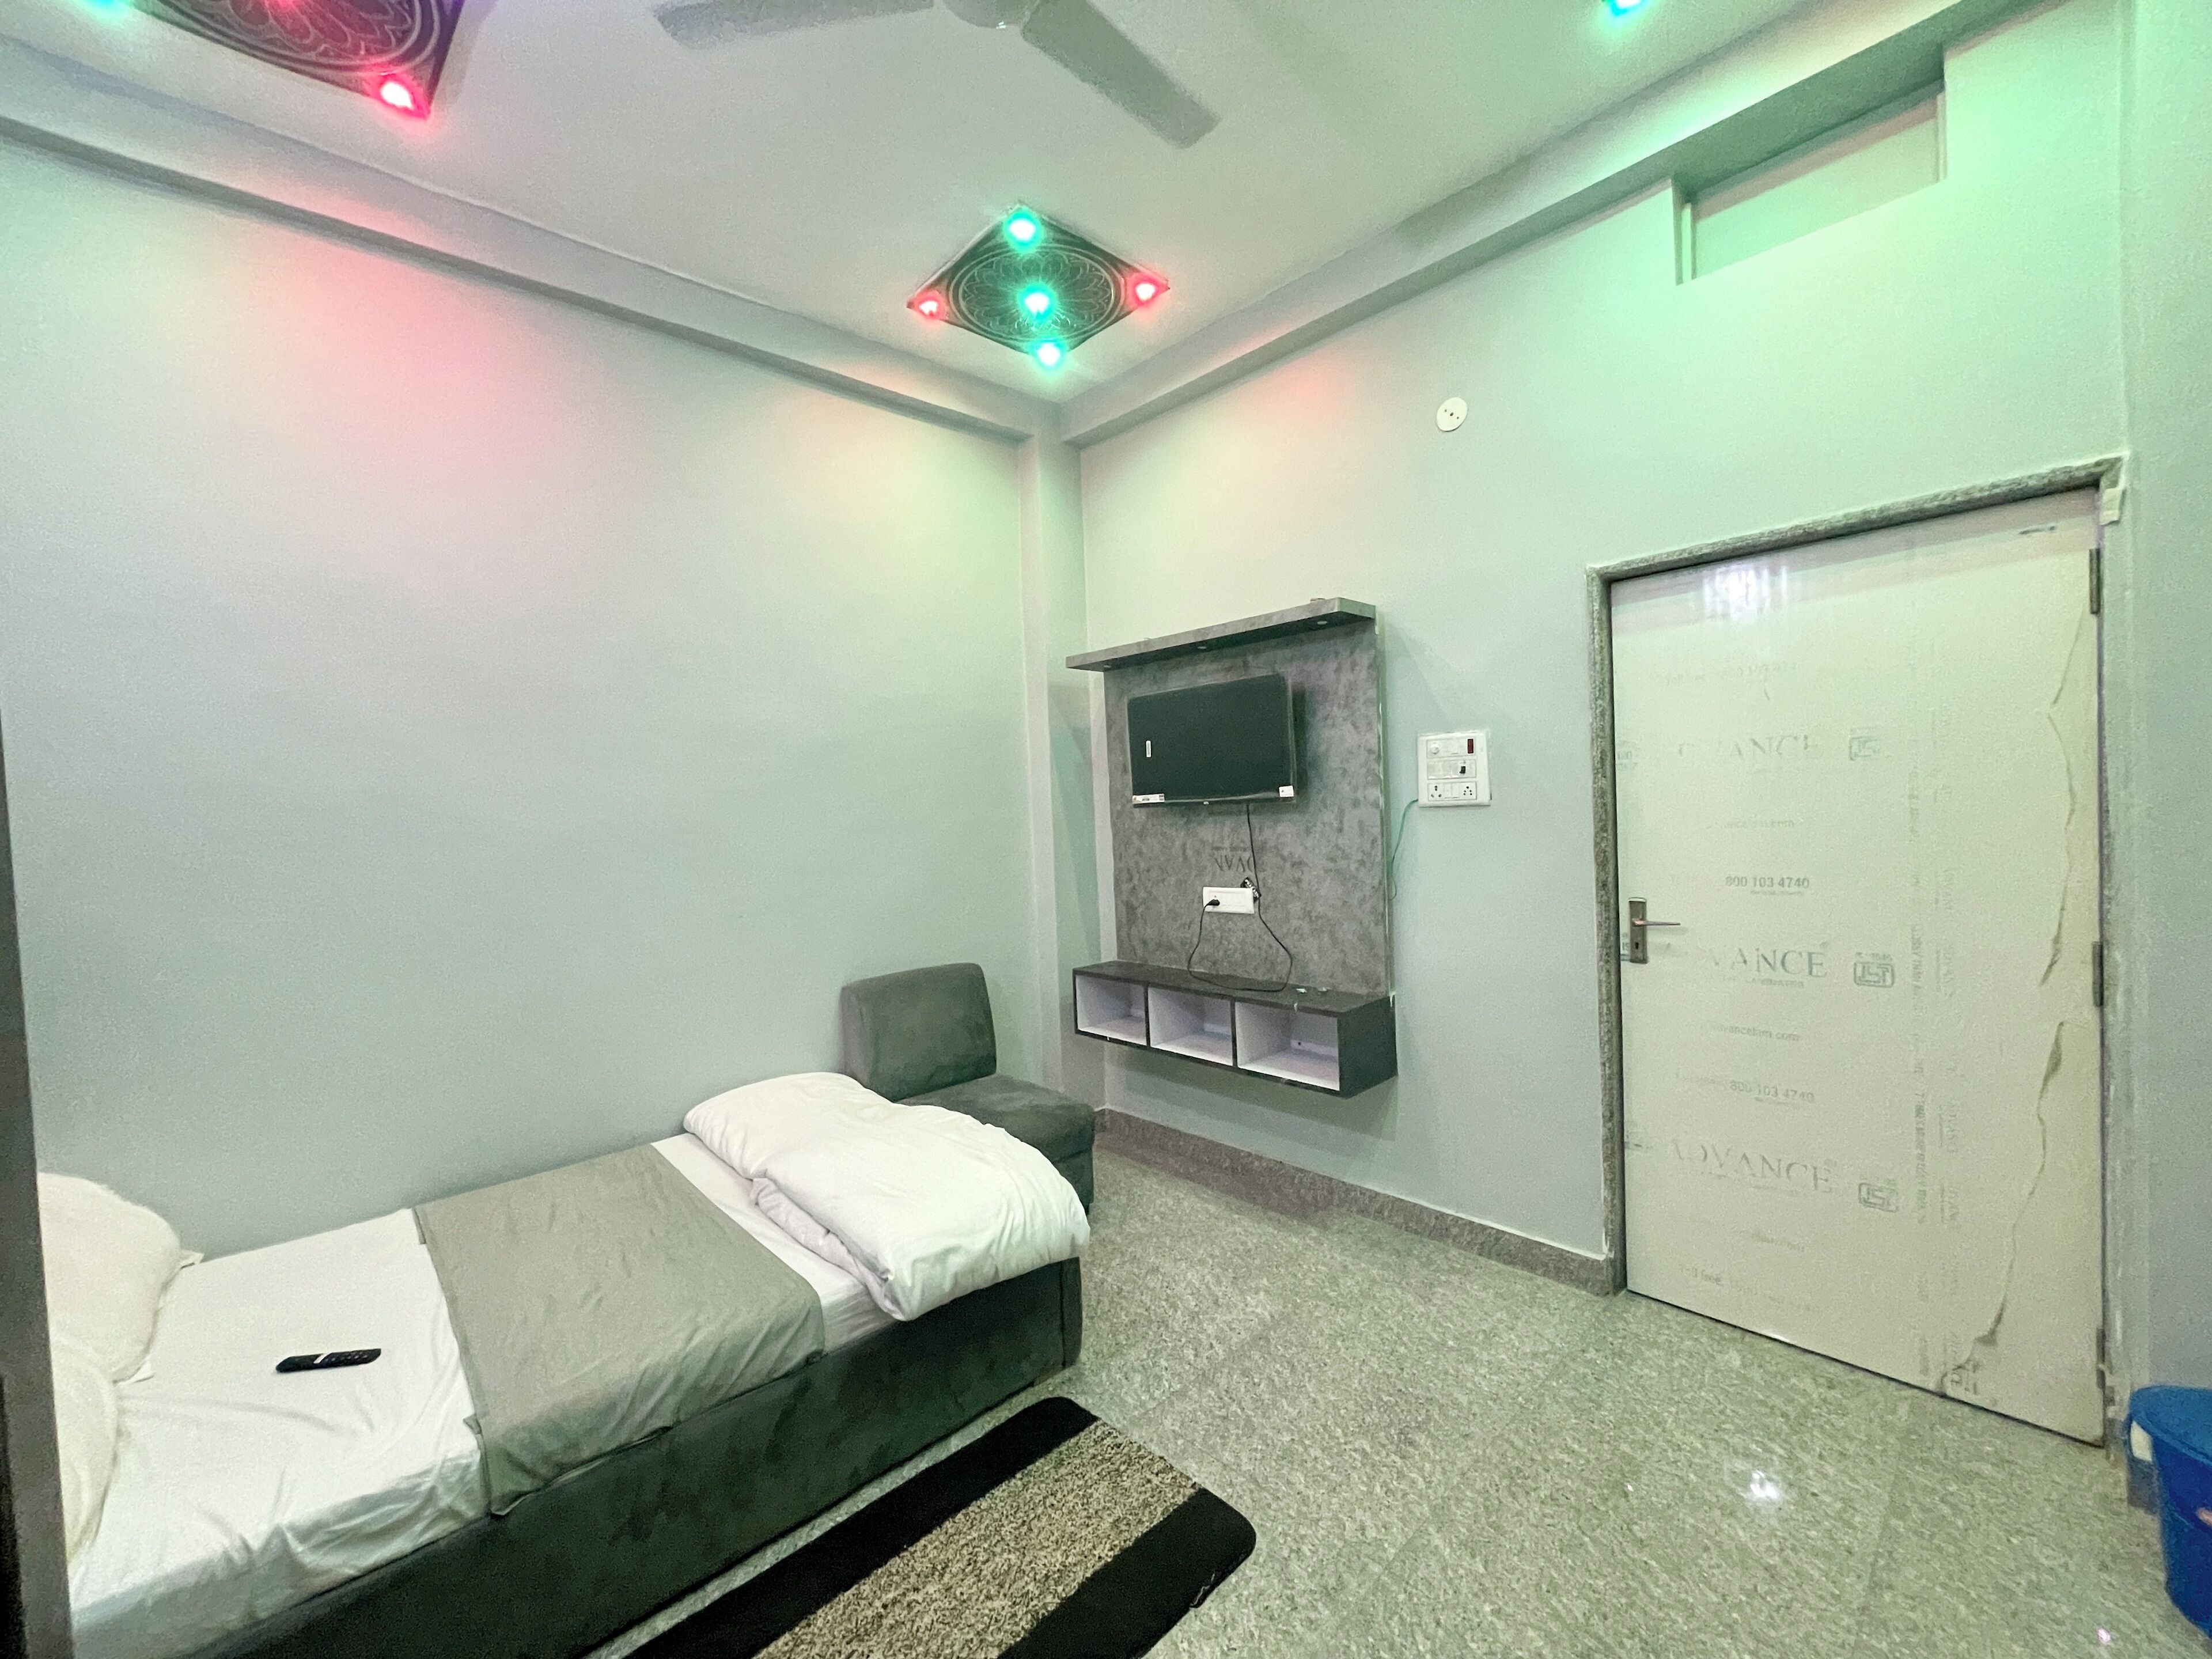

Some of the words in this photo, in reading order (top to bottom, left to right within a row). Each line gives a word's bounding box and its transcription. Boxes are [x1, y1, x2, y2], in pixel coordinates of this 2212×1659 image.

[1752, 876, 1774, 888] 103
[1778, 876, 1810, 889] 4740
[1756, 1083, 1779, 1098] 103
